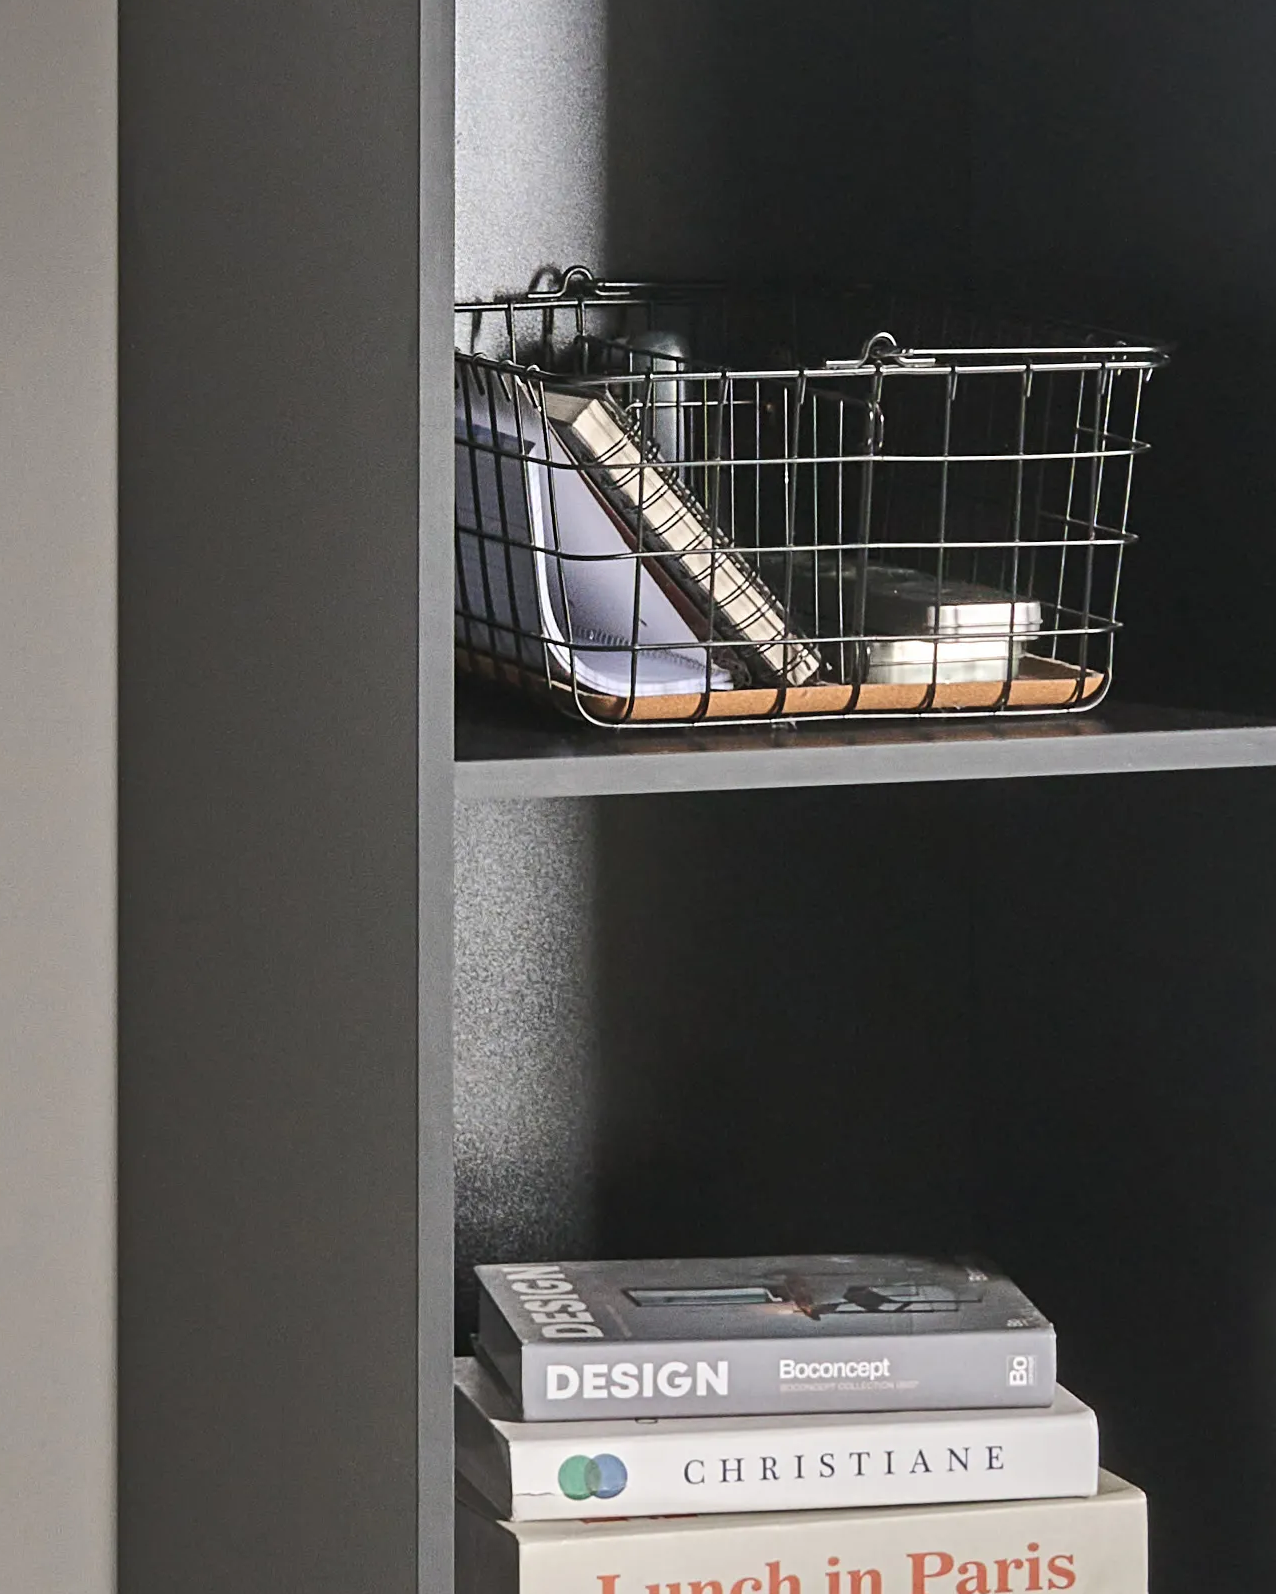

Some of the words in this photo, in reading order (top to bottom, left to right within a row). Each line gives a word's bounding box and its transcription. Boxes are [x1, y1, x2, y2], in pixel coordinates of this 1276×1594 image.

[503, 1264, 605, 1338] DESIGN
[545, 1360, 729, 1400] DESIGN
[683, 1445, 1006, 1485] CHRISTIANE
